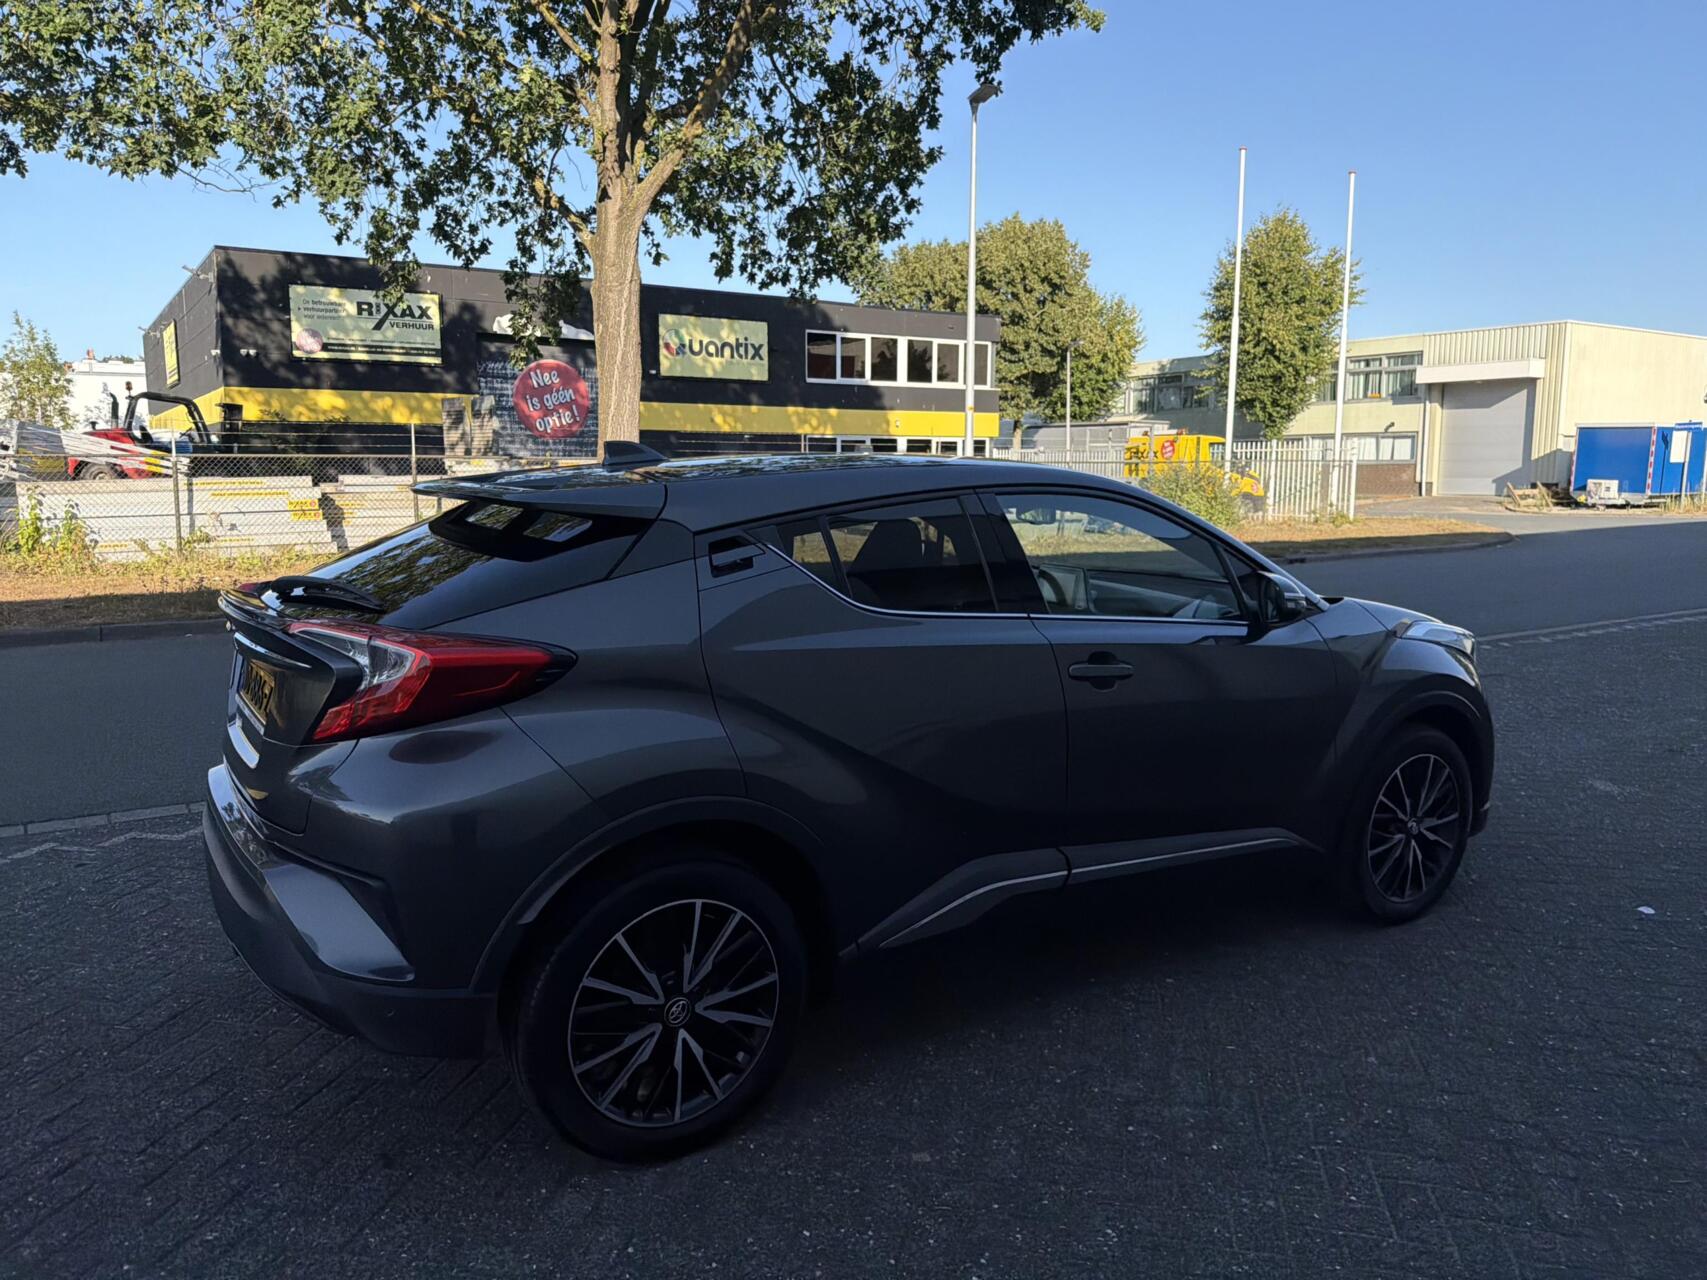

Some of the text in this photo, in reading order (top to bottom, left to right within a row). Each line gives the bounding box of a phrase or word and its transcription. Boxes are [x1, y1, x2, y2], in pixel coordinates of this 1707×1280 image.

[389, 321, 435, 331] VERHUUR
[529, 369, 560, 388] Nee
[526, 394, 541, 412] is
[543, 386, 576, 410] géén
[535, 404, 580, 433] optie!
